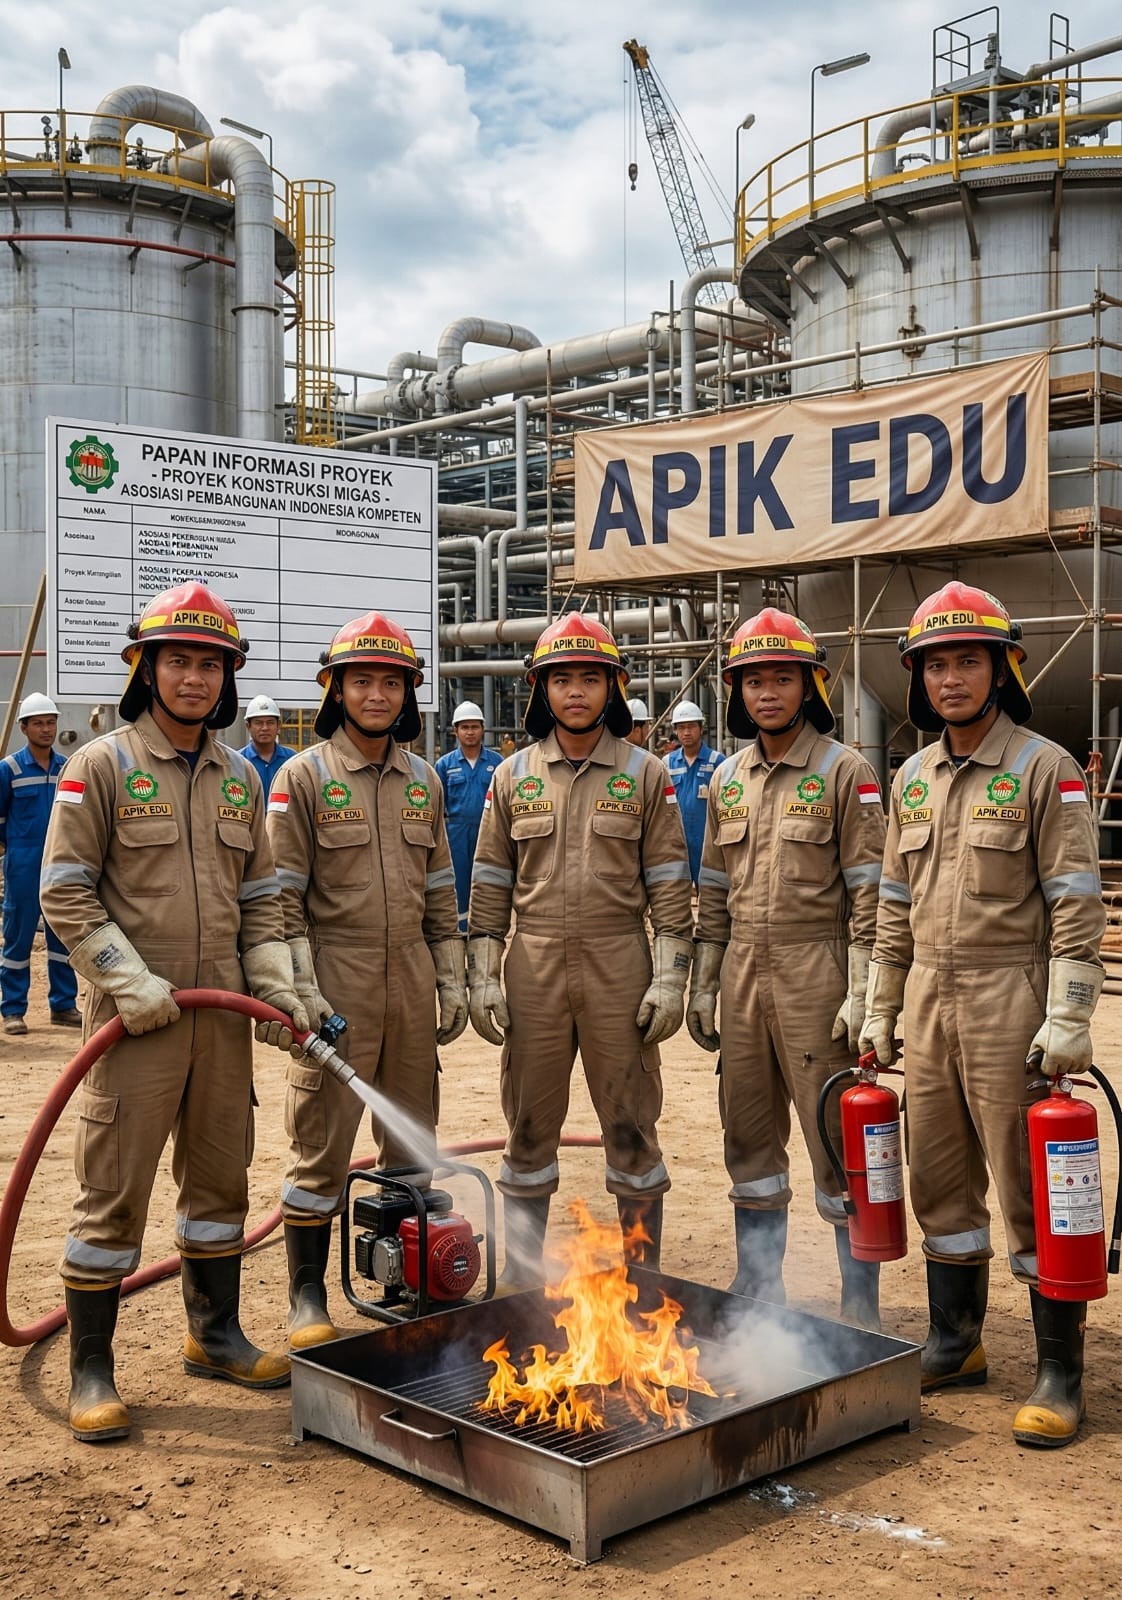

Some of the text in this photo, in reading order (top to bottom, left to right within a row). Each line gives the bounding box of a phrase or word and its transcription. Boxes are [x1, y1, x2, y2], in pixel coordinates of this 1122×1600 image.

[142, 444, 393, 487] PAPAN INFORMASI PROYEK
[588, 392, 1028, 551] APIK EDU
[162, 468, 227, 488] PROYEK
[232, 476, 330, 499] KONSTRUKSI
[334, 486, 381, 503] MIGAS
[120, 483, 422, 524] ASOSIASI PEMBANGUNAN INDONESIA KOMPETEN
[83, 507, 106, 515] NAMA
[138, 566, 171, 574] ASOSIASI
[173, 612, 223, 629] APIK EDU
[926, 613, 974, 630] APIK EDU
[356, 638, 399, 651] APIK EDU
[553, 638, 595, 651] APIK EDU
[743, 637, 786, 651] APIK EDU
[123, 805, 168, 817] APIK EDU
[514, 802, 549, 814] APIK EDU
[600, 802, 639, 813] APIK EDU
[789, 805, 828, 816] APIK EDU
[976, 807, 1021, 819] APIK EDU
[321, 810, 361, 821] APIK EDU
[914, 811, 928, 820] EDU
